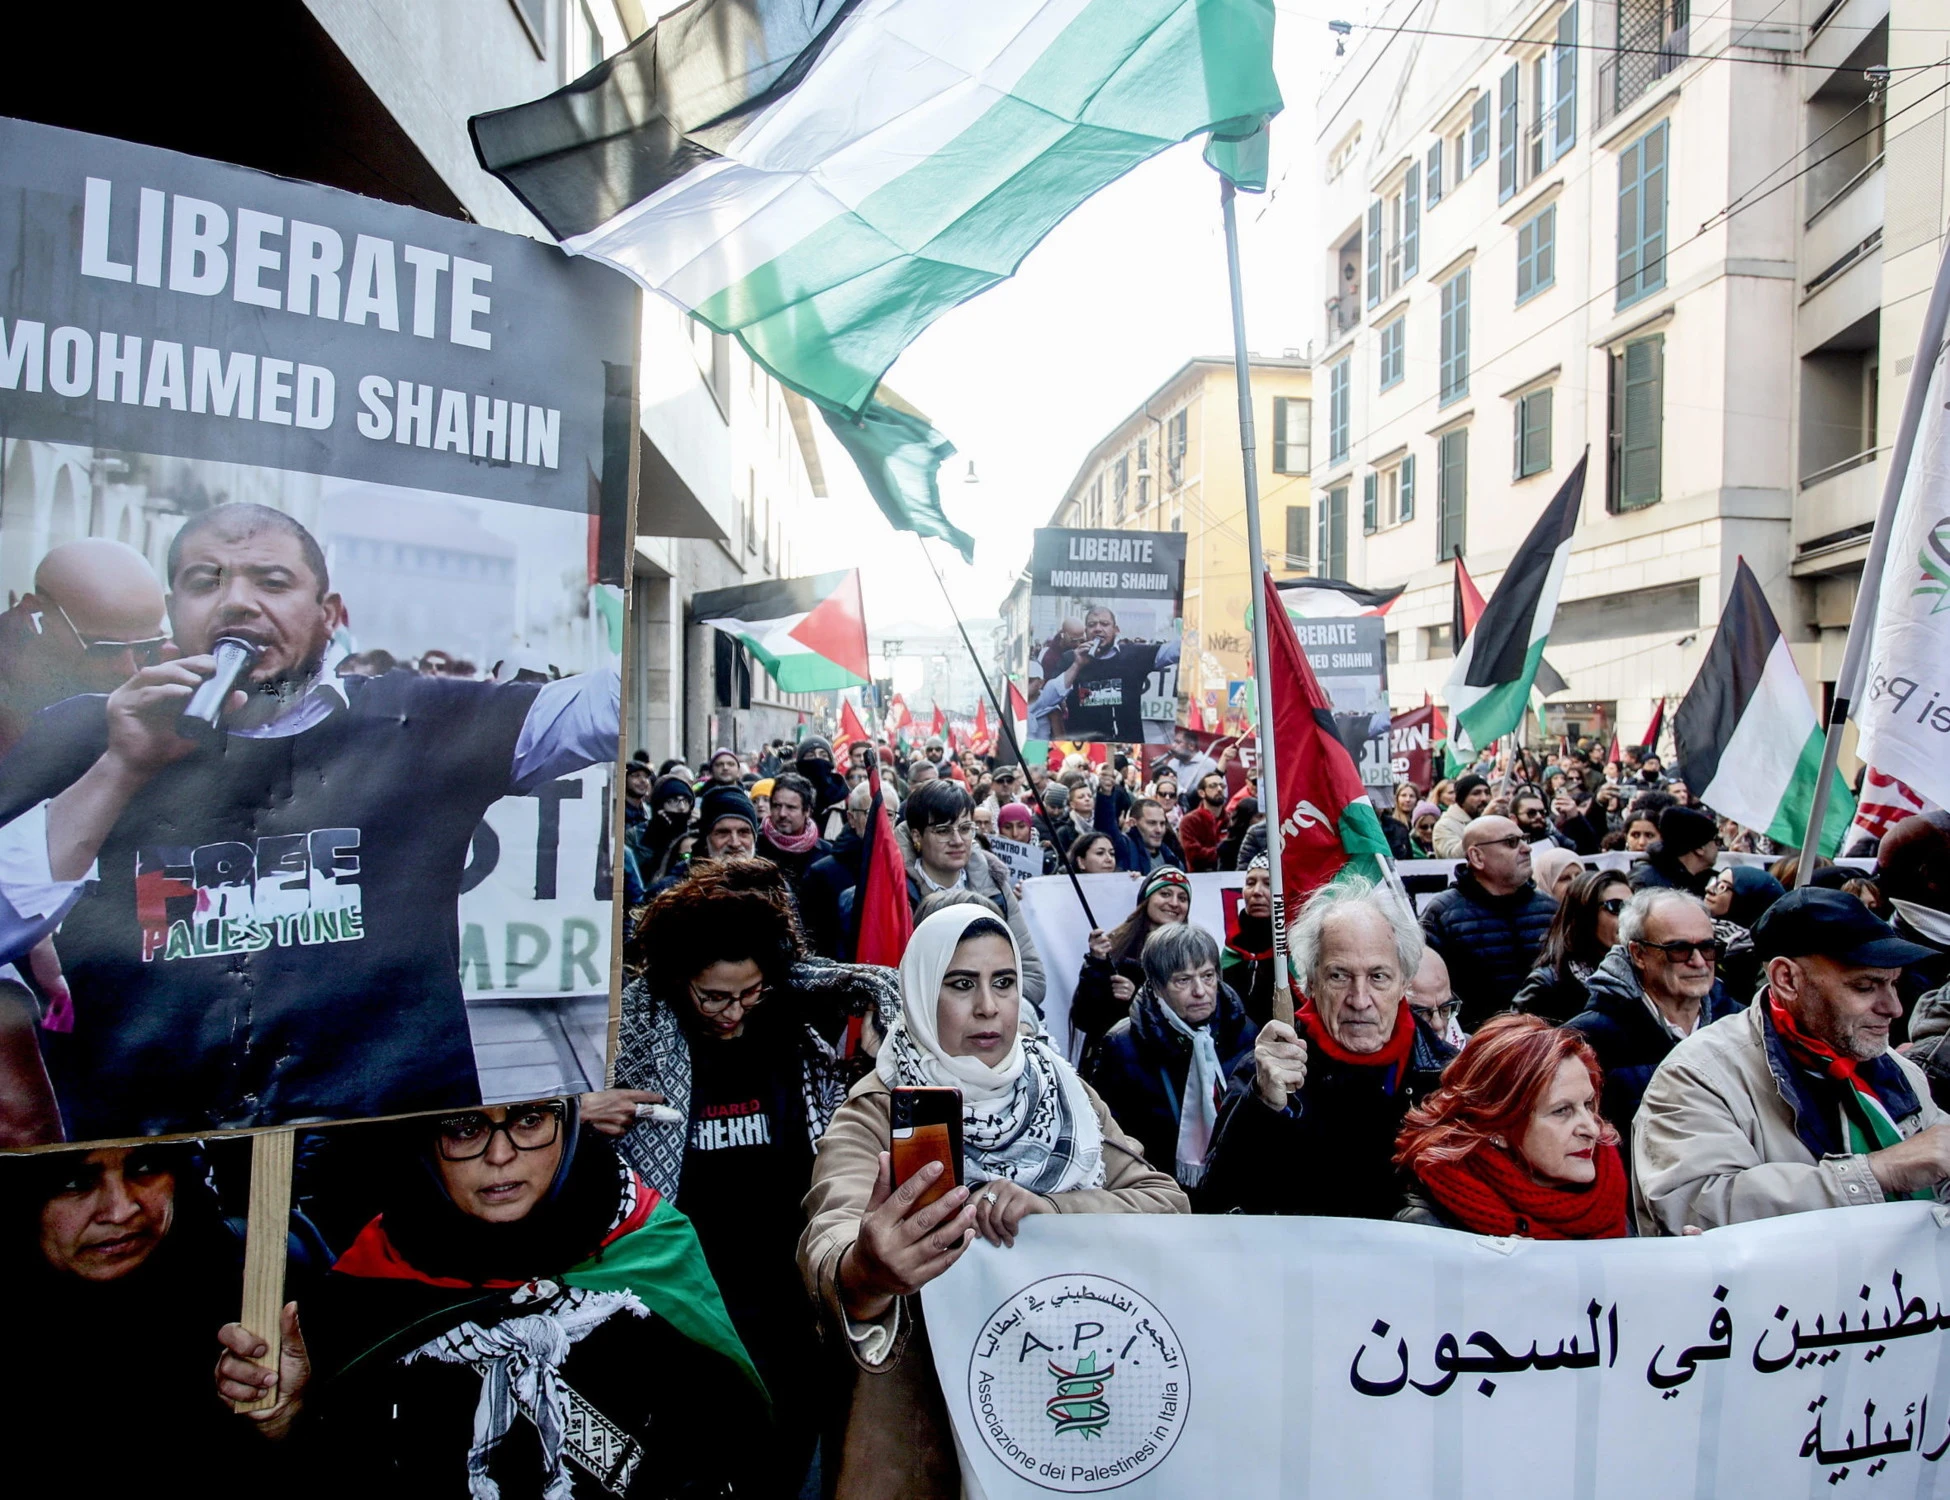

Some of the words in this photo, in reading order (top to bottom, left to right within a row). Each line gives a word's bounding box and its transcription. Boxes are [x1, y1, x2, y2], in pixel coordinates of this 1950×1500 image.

[81, 177, 492, 350] LIBERATE
[0, 316, 336, 431] MOHAMED
[357, 375, 561, 469] SHAHIN
[1069, 537, 1153, 563] LIBERATE
[1051, 570, 1118, 588] MOHAMED
[1121, 572, 1169, 590] SHAHIN
[1332, 652, 1373, 668] SHAHIN
[990, 839, 1020, 855] CONTRO
[135, 828, 361, 925] FREE
[142, 904, 365, 963] PALESTINE
[1273, 893, 1288, 958] PALESTINE
[1050, 1285, 1138, 1316] الفلسطيني
[1135, 1317, 1180, 1369] التجمع
[1349, 1297, 1619, 1398] السجون
[1646, 1284, 1733, 1400] في
[978, 1370, 1037, 1470] Associazione
[1157, 1382, 1179, 1423] Italia
[1149, 1425, 1170, 1442] in
[1039, 1461, 1066, 1481] dei
[1071, 1438, 1158, 1482] Palestinesi
